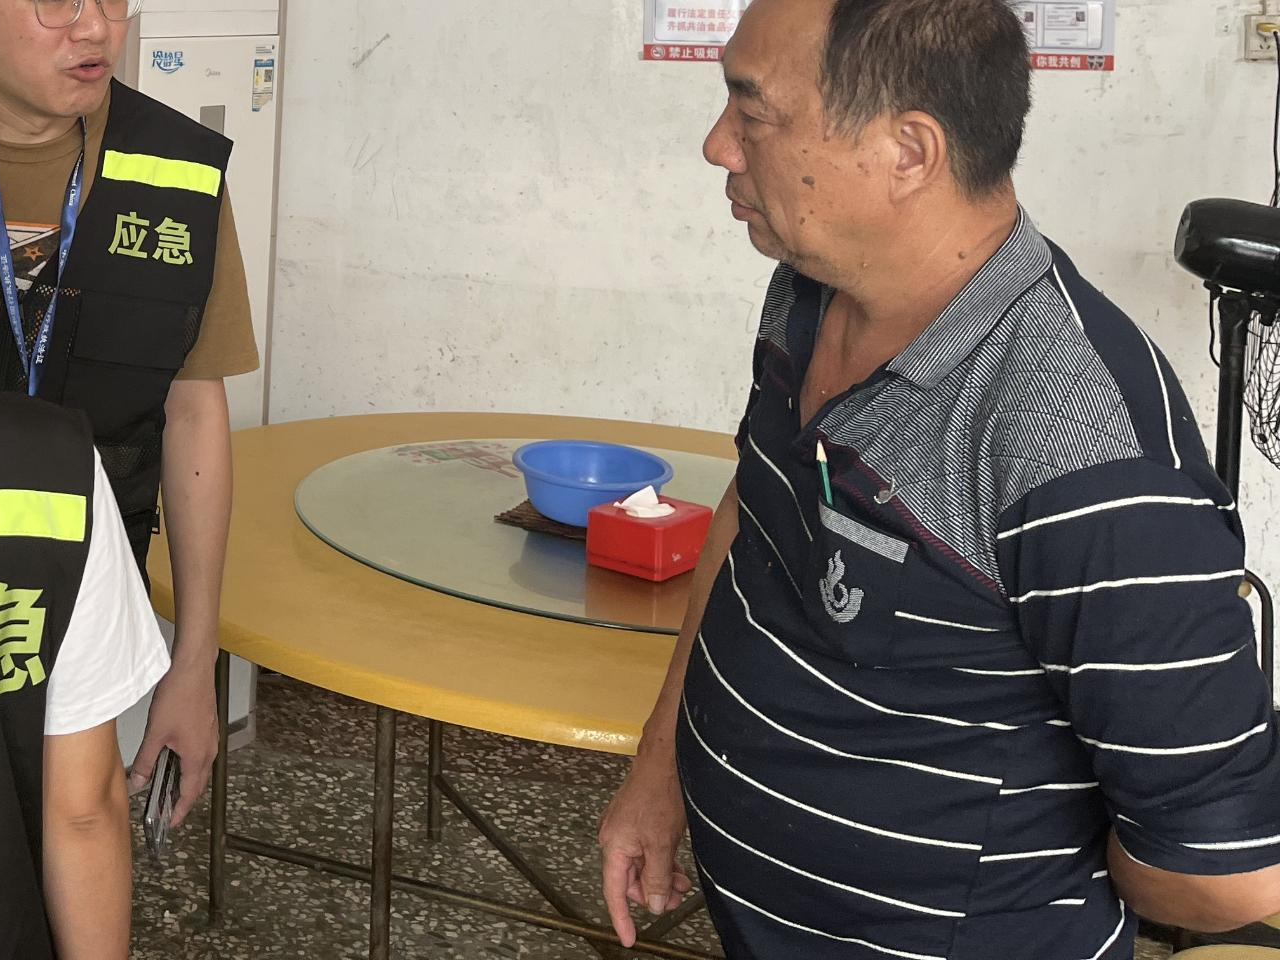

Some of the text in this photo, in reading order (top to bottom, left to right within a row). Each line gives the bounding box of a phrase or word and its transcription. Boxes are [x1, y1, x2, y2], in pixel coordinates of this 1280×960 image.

[668, 47, 719, 59] 禁止吸烟
[108, 211, 194, 266] 应急
